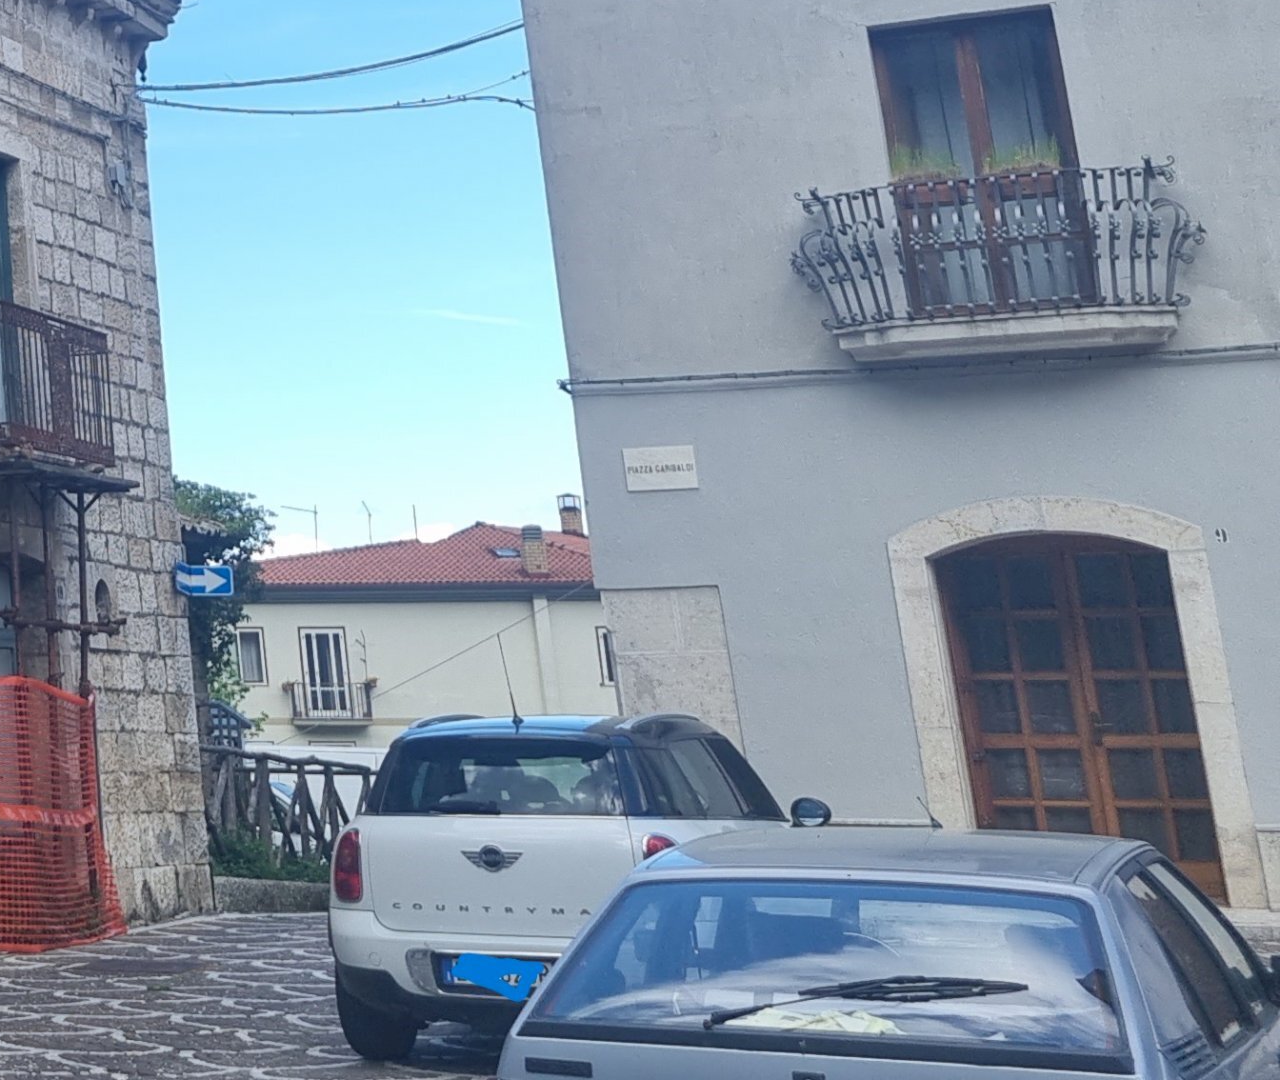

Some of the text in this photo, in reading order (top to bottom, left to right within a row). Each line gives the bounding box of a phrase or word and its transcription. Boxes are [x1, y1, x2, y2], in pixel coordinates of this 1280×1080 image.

[627, 463, 694, 474] PIAZZA GARIBALDI
[1215, 528, 1228, 543] 9
